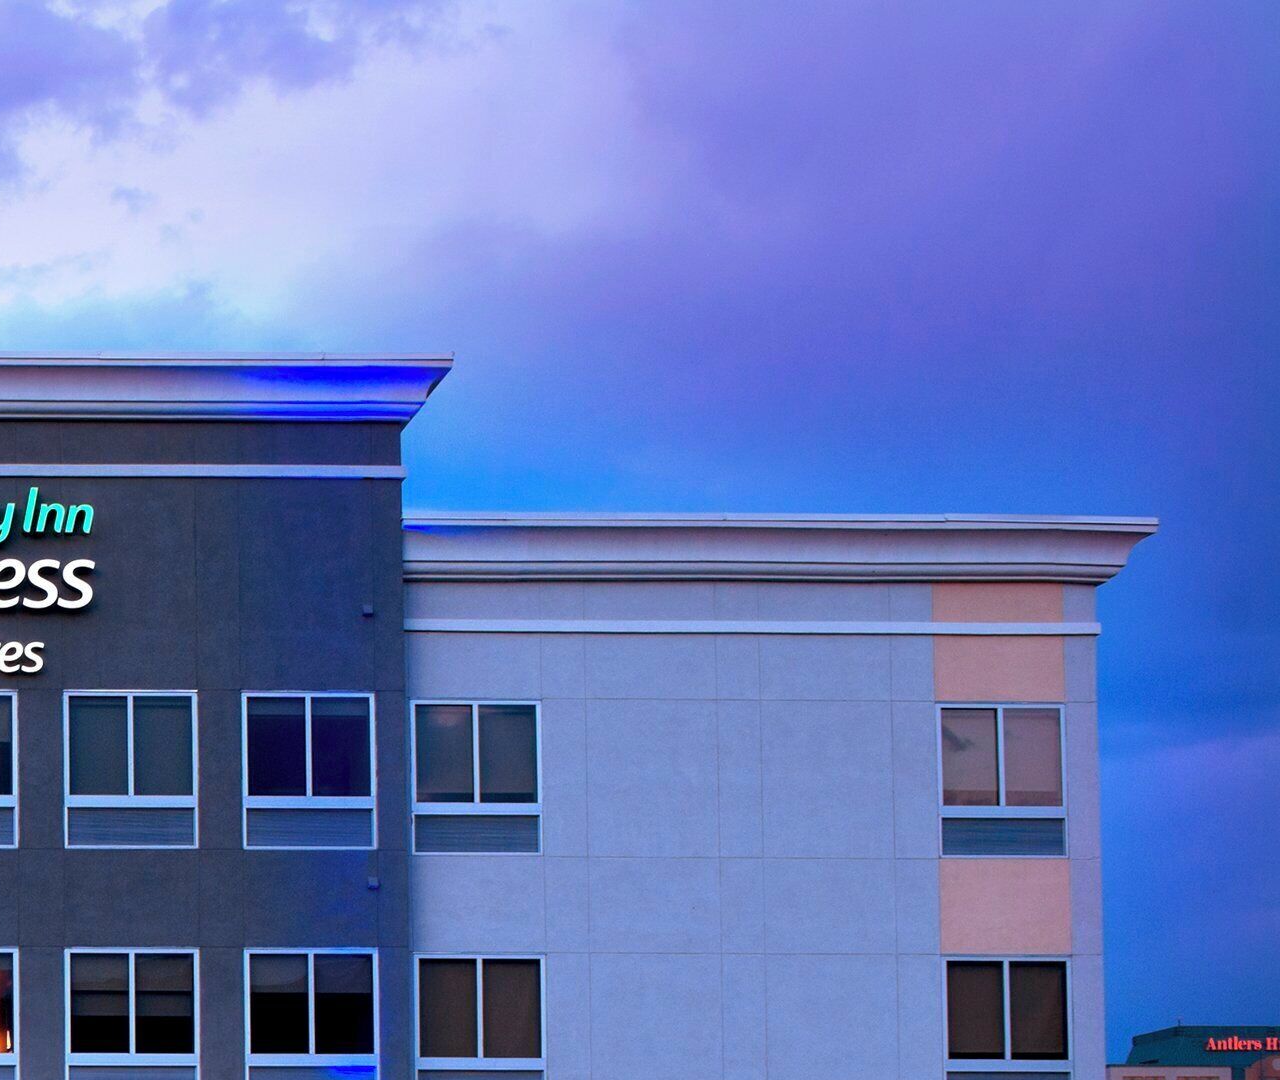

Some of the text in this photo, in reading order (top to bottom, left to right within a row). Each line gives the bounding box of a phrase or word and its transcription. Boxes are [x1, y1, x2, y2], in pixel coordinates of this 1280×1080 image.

[22, 486, 95, 535] Inn
[1206, 1036, 1280, 1050] Antlers H
